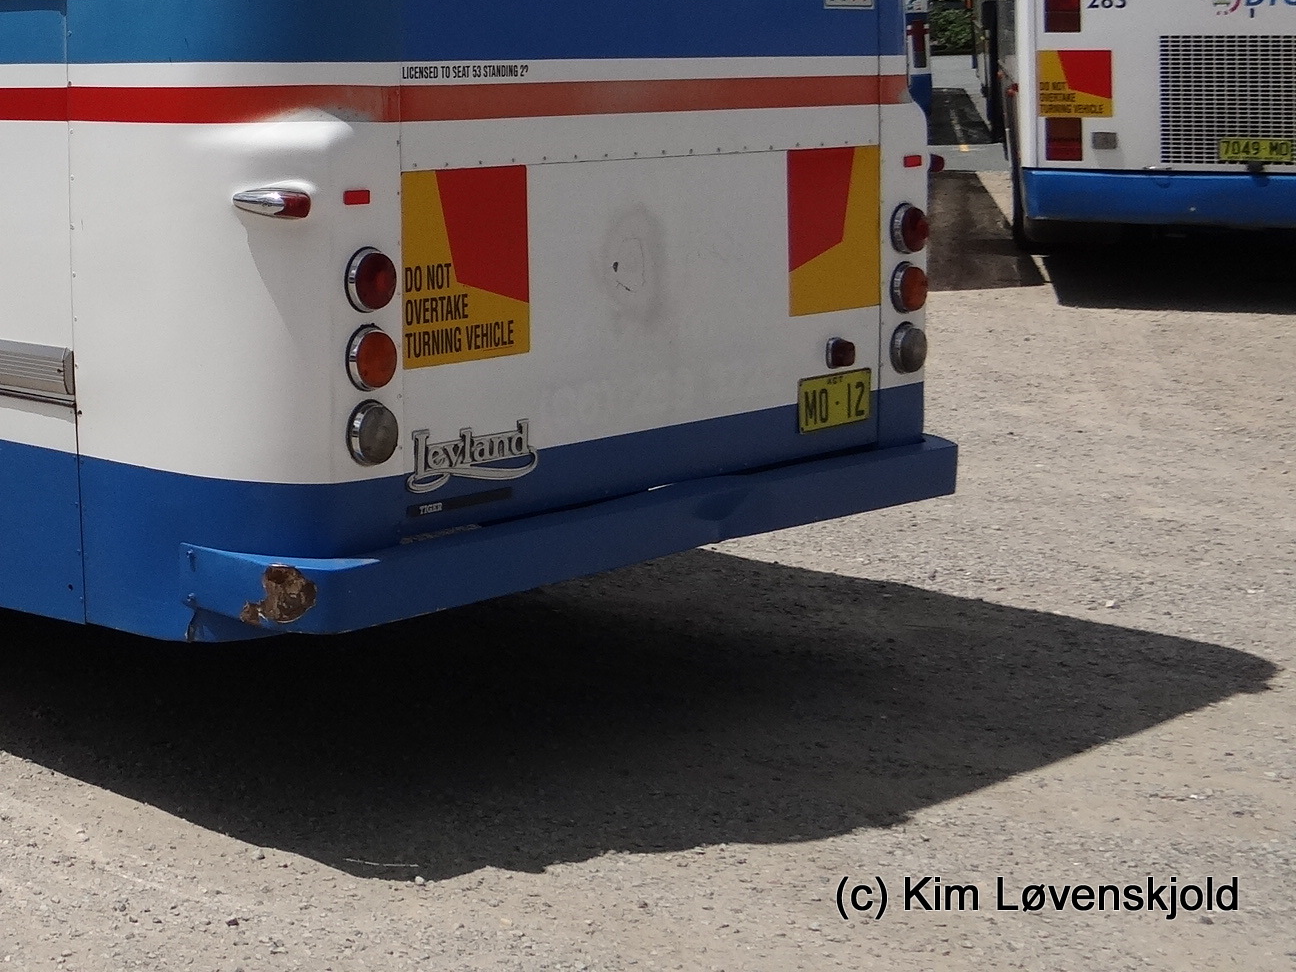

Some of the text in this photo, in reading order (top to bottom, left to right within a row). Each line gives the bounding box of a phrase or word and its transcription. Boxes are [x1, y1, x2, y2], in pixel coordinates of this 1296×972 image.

[402, 66, 439, 79] LICENSED
[441, 66, 450, 78] TO
[453, 65, 470, 78] SEAT
[472, 65, 482, 78] 53
[483, 65, 518, 78] STANDING
[1221, 140, 1261, 155] 7049
[404, 263, 452, 293] DO NOT
[405, 293, 469, 326] OVERTAKE
[404, 319, 515, 359] TURNING VEHICLE
[407, 418, 538, 494] Leyland
[418, 502, 443, 515] TIGER
